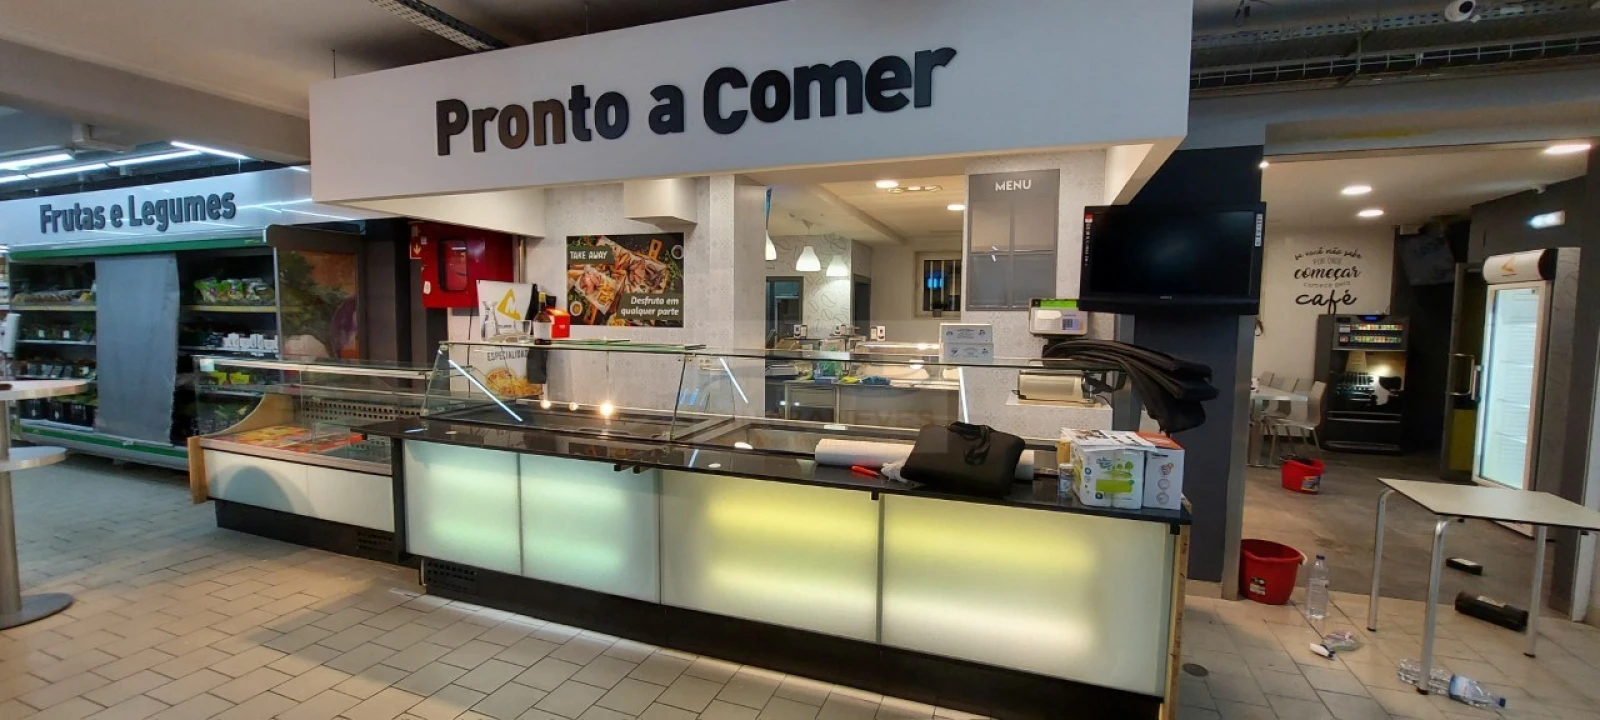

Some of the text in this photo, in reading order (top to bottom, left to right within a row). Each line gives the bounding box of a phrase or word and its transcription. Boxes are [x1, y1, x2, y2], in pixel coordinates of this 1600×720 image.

[436, 47, 957, 156] Pronto a Comer
[995, 179, 1032, 191] MENU
[40, 192, 236, 233] Frutas e Legumes
[569, 250, 608, 259] TAKE AWAY
[1326, 247, 1342, 255] não
[1294, 266, 1361, 281] começar
[630, 296, 679, 306] Desfruta em
[1296, 289, 1357, 315] café
[621, 308, 679, 317] qualquer parte
[487, 350, 528, 361] ESPECIALIDAD
